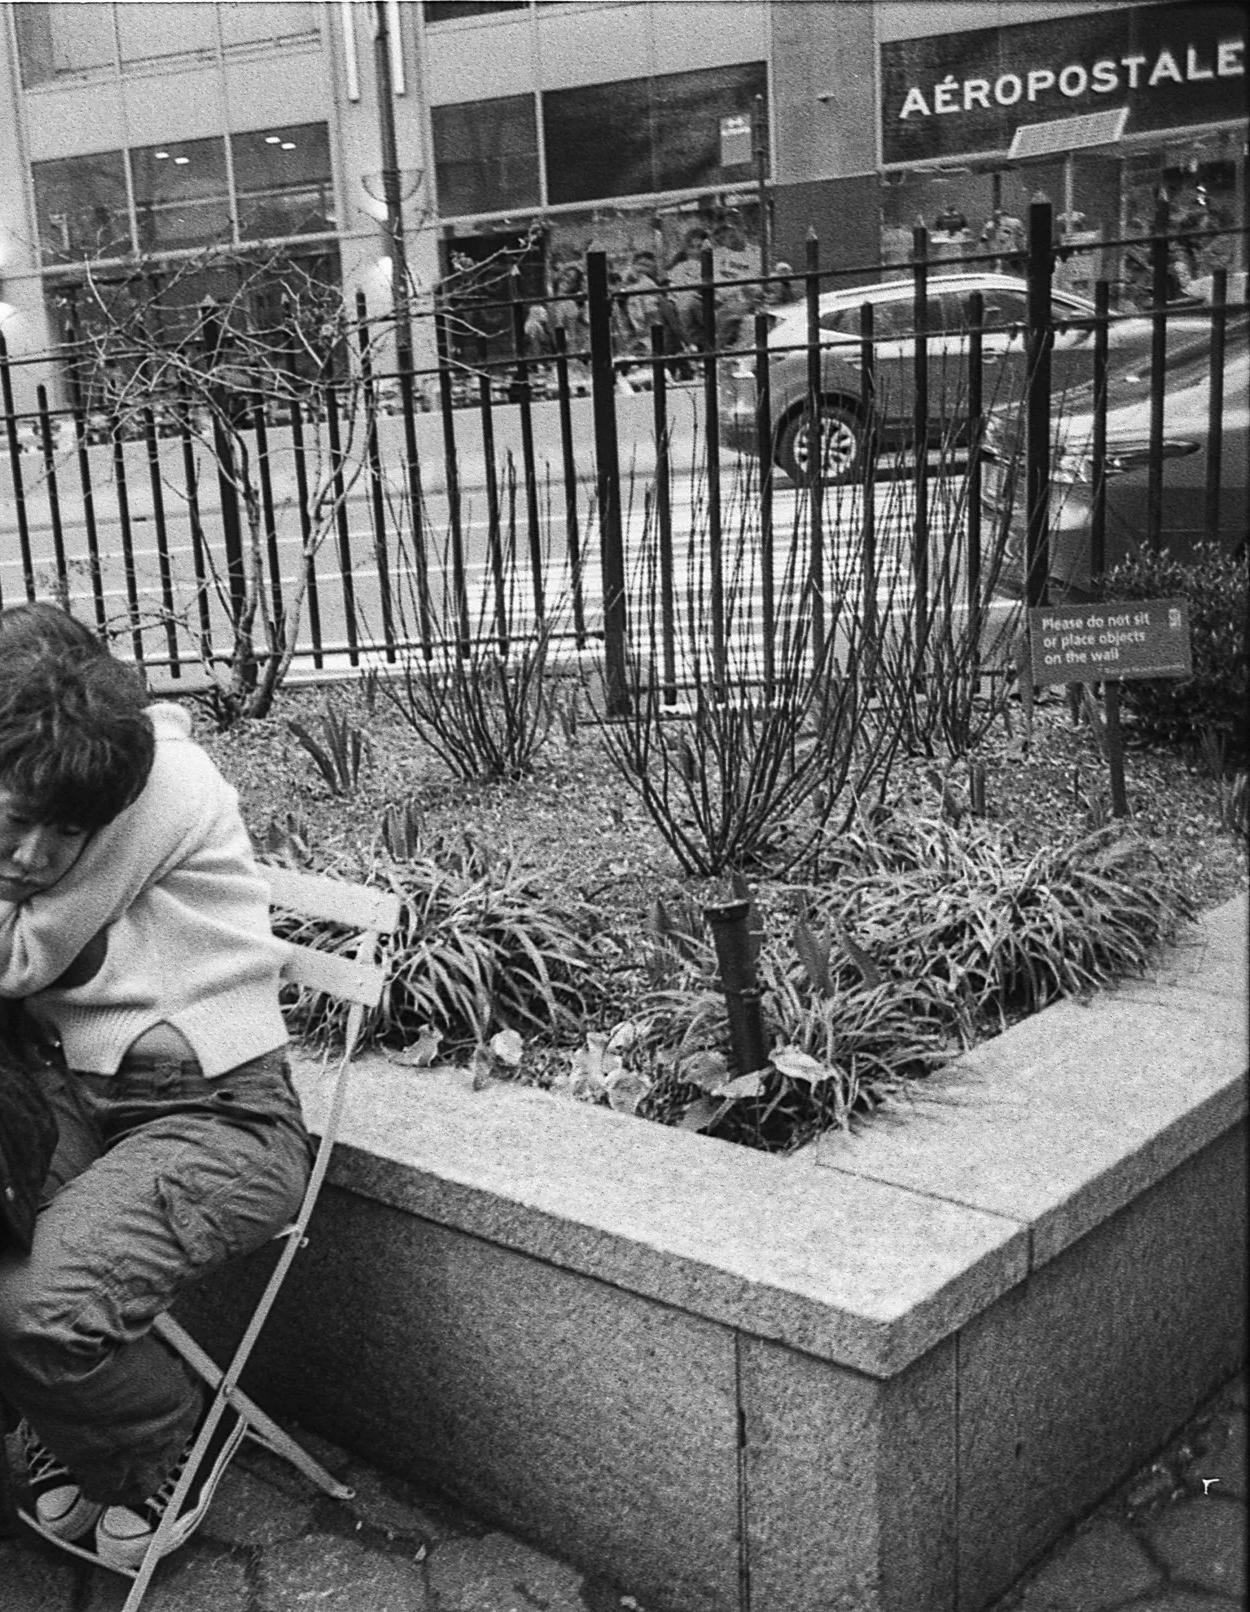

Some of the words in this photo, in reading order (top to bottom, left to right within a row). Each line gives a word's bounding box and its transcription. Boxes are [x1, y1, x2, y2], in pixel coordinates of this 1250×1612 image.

[899, 40, 1246, 119] AÉROPOSTALE
[1042, 616, 1084, 631] Please
[1086, 614, 1104, 629] do
[1107, 613, 1131, 627] not
[1133, 611, 1151, 626] sit
[1042, 637, 1058, 649] or
[1061, 633, 1096, 650] place
[1098, 630, 1146, 647] objects
[1044, 653, 1063, 665] on
[1065, 650, 1087, 664] the
[1090, 647, 1120, 662] wall
